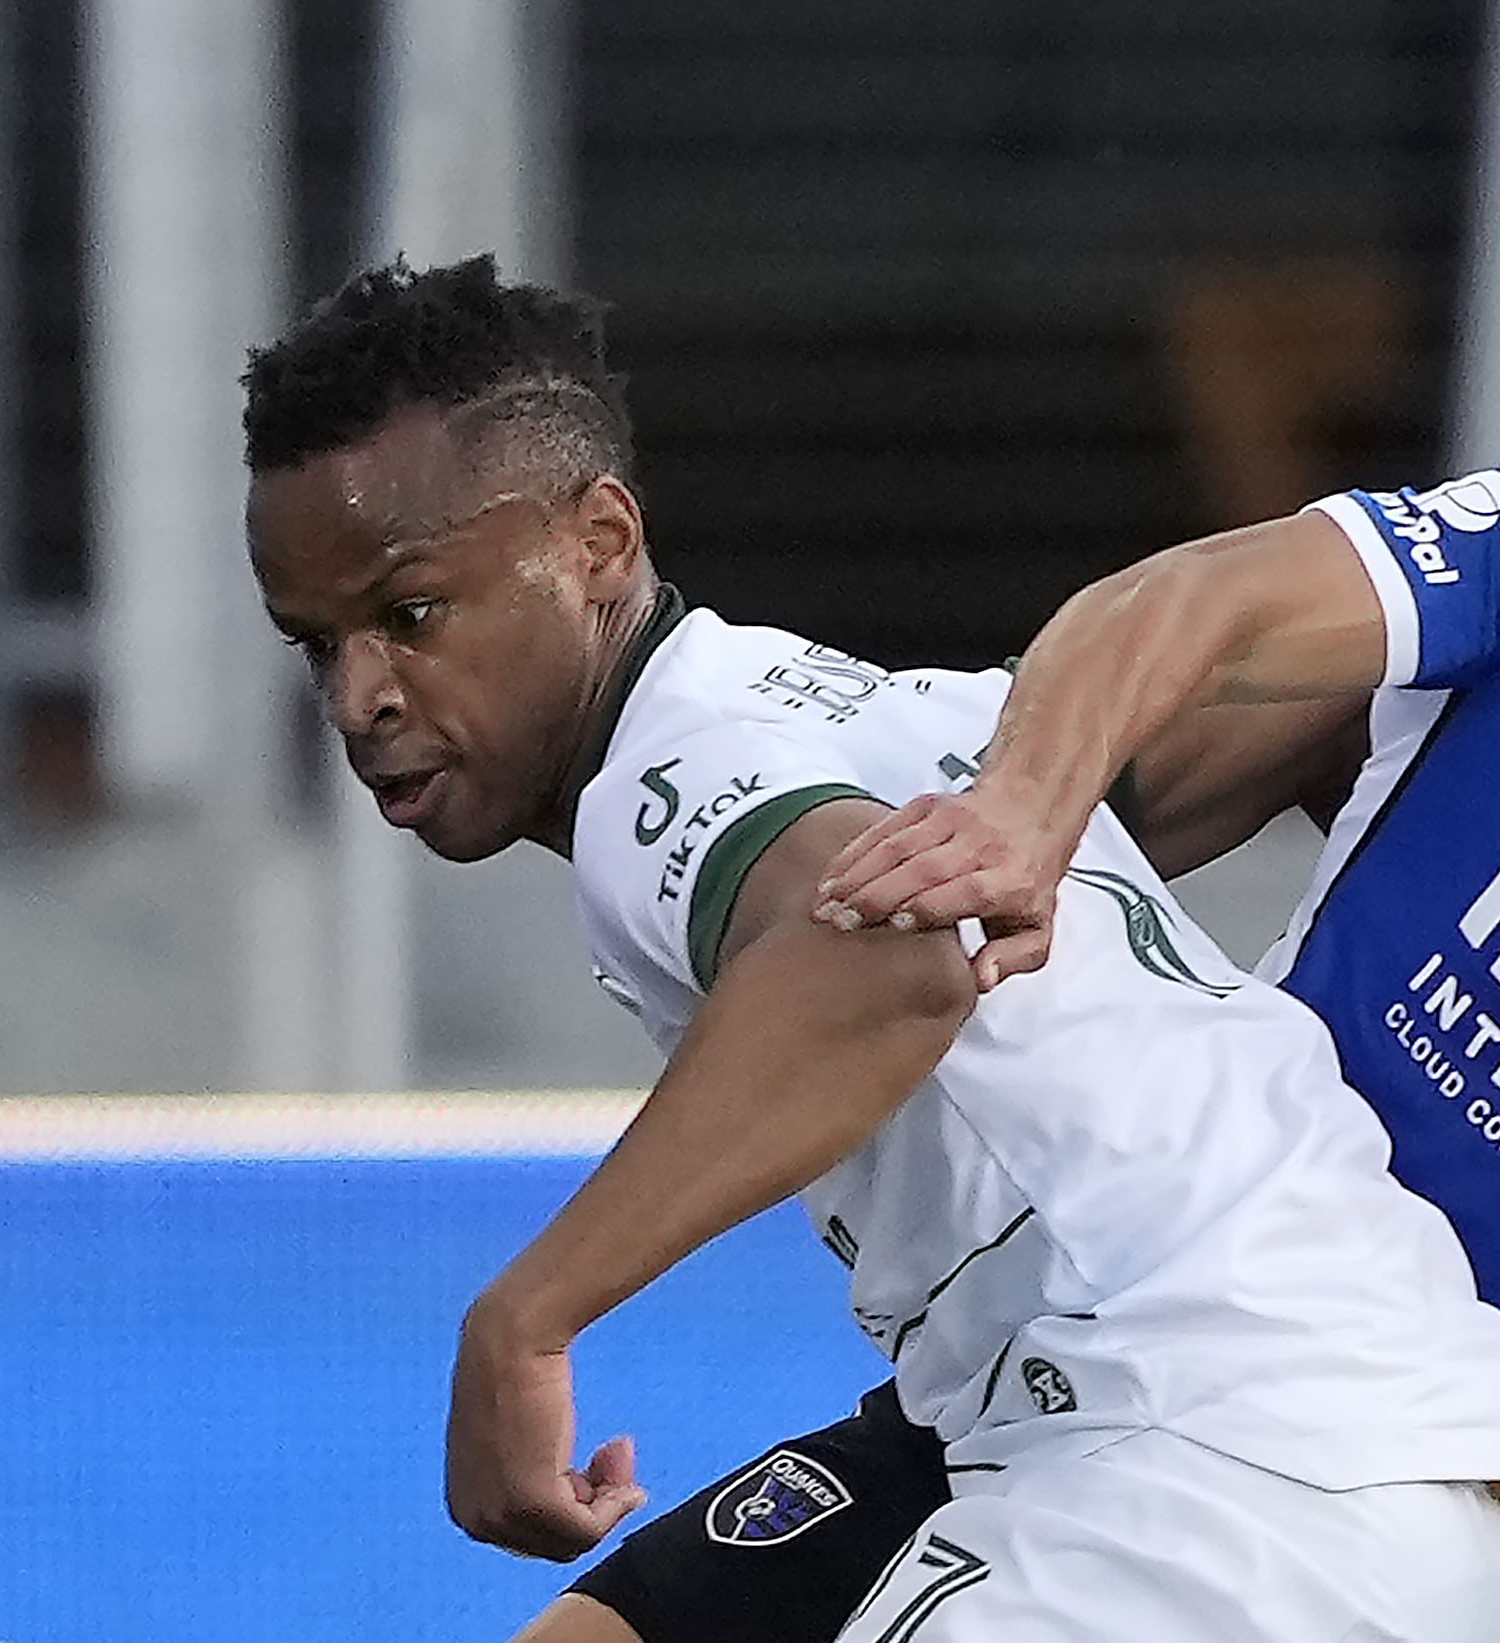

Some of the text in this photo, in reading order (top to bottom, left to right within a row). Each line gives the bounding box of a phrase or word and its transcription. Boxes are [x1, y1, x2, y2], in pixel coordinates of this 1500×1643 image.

[657, 770, 770, 903] TikTok
[1384, 1003, 1467, 1099] CLOUD
[770, 1458, 840, 1507] QUAKES
